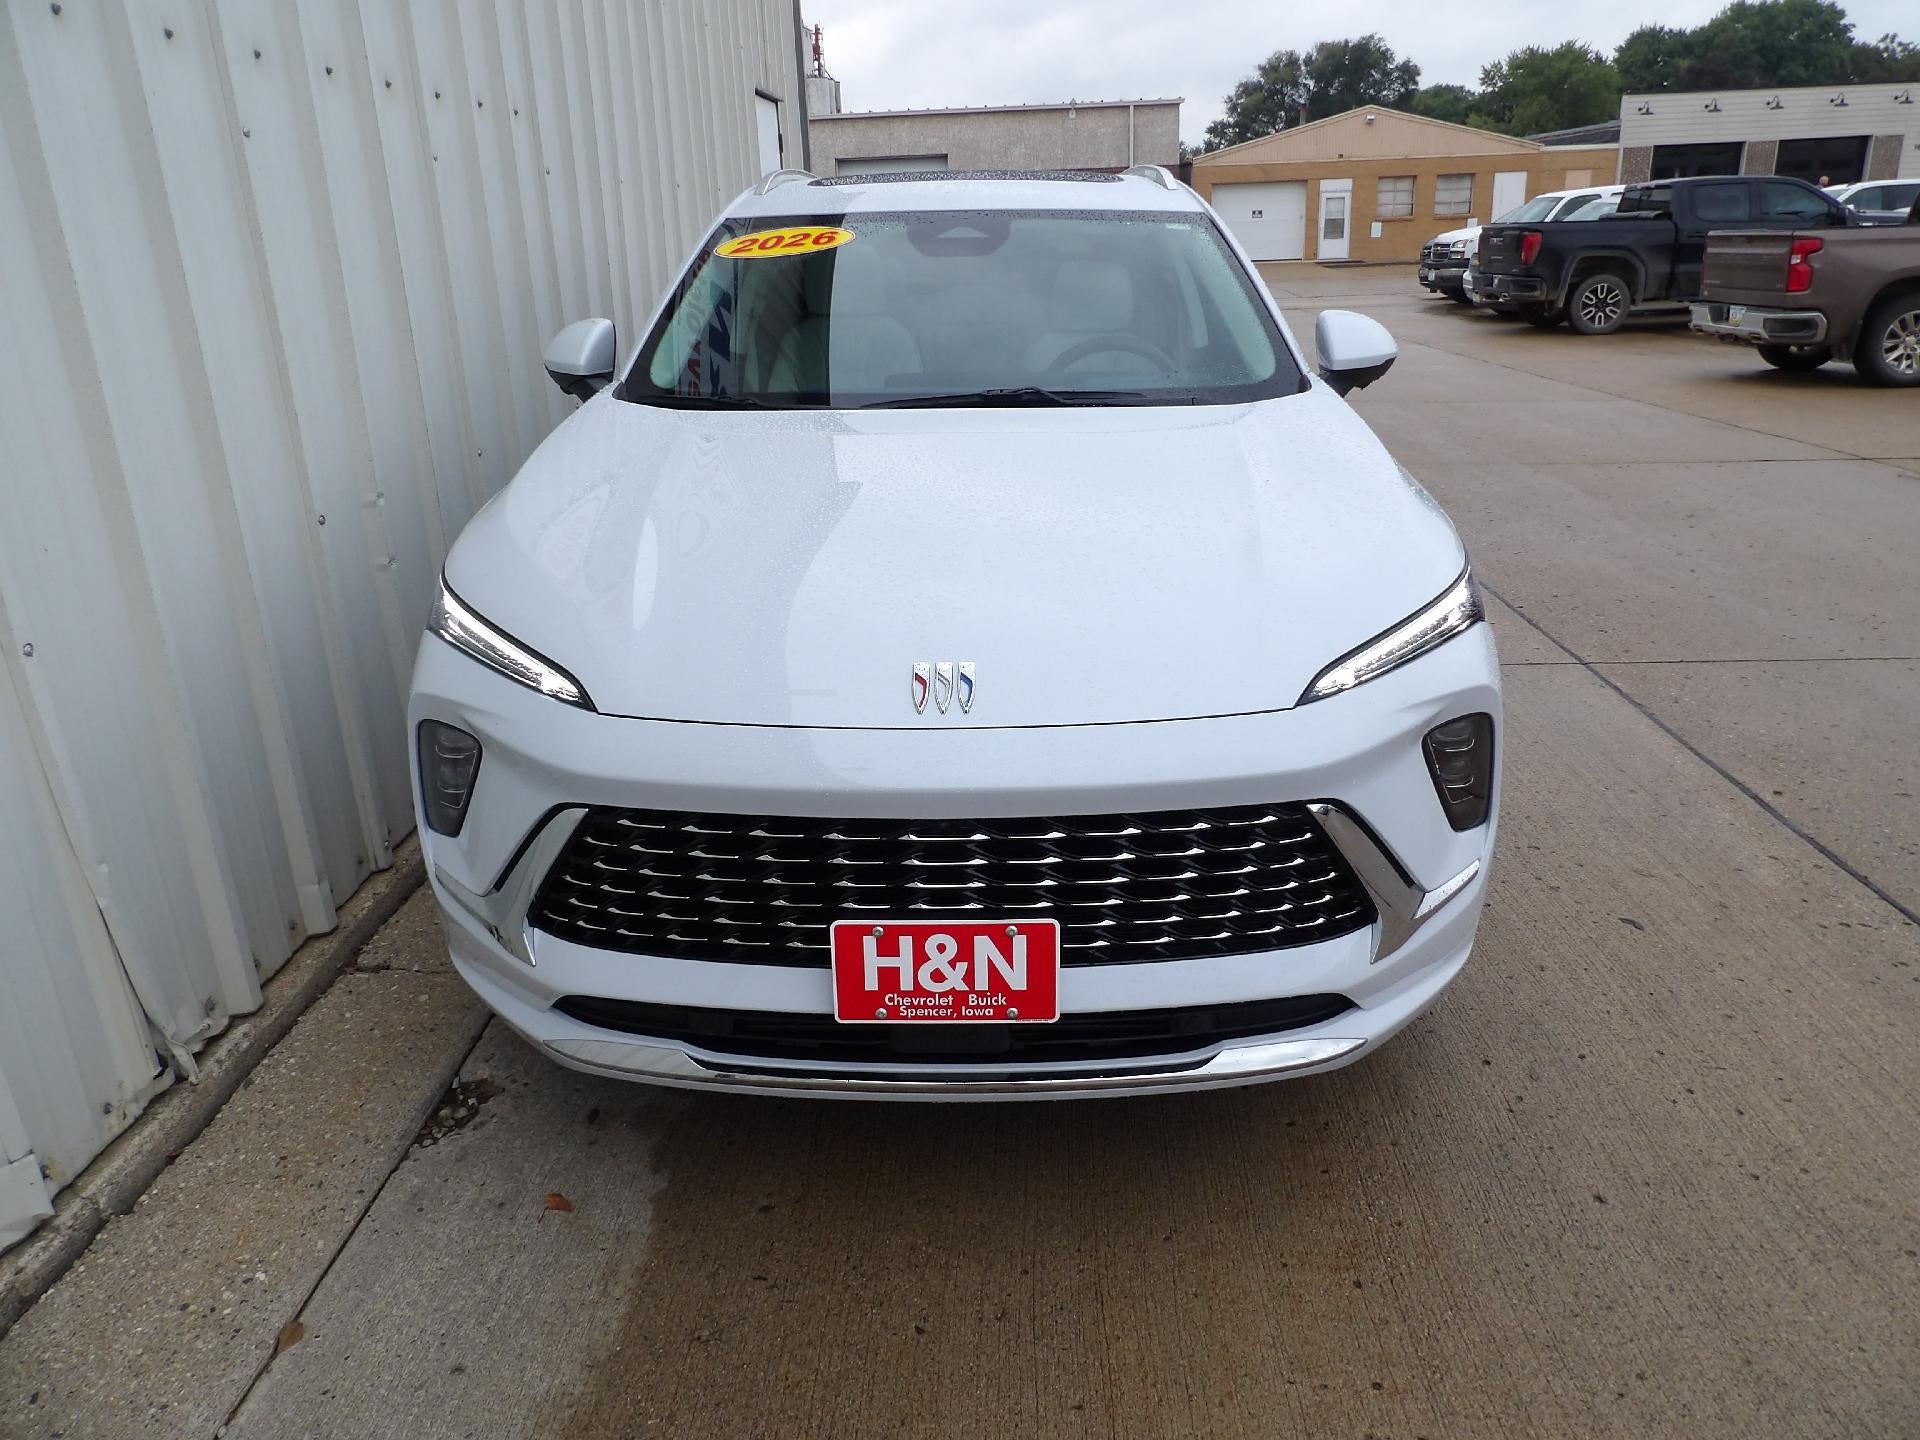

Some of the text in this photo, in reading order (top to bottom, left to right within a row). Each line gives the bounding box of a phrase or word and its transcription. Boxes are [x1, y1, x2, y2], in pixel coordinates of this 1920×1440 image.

[728, 231, 839, 255] 2026
[863, 934, 1027, 992] H&N
[885, 992, 1007, 1006] Chevrolet Buick
[899, 1006, 994, 1018] Spencer, Iowa
